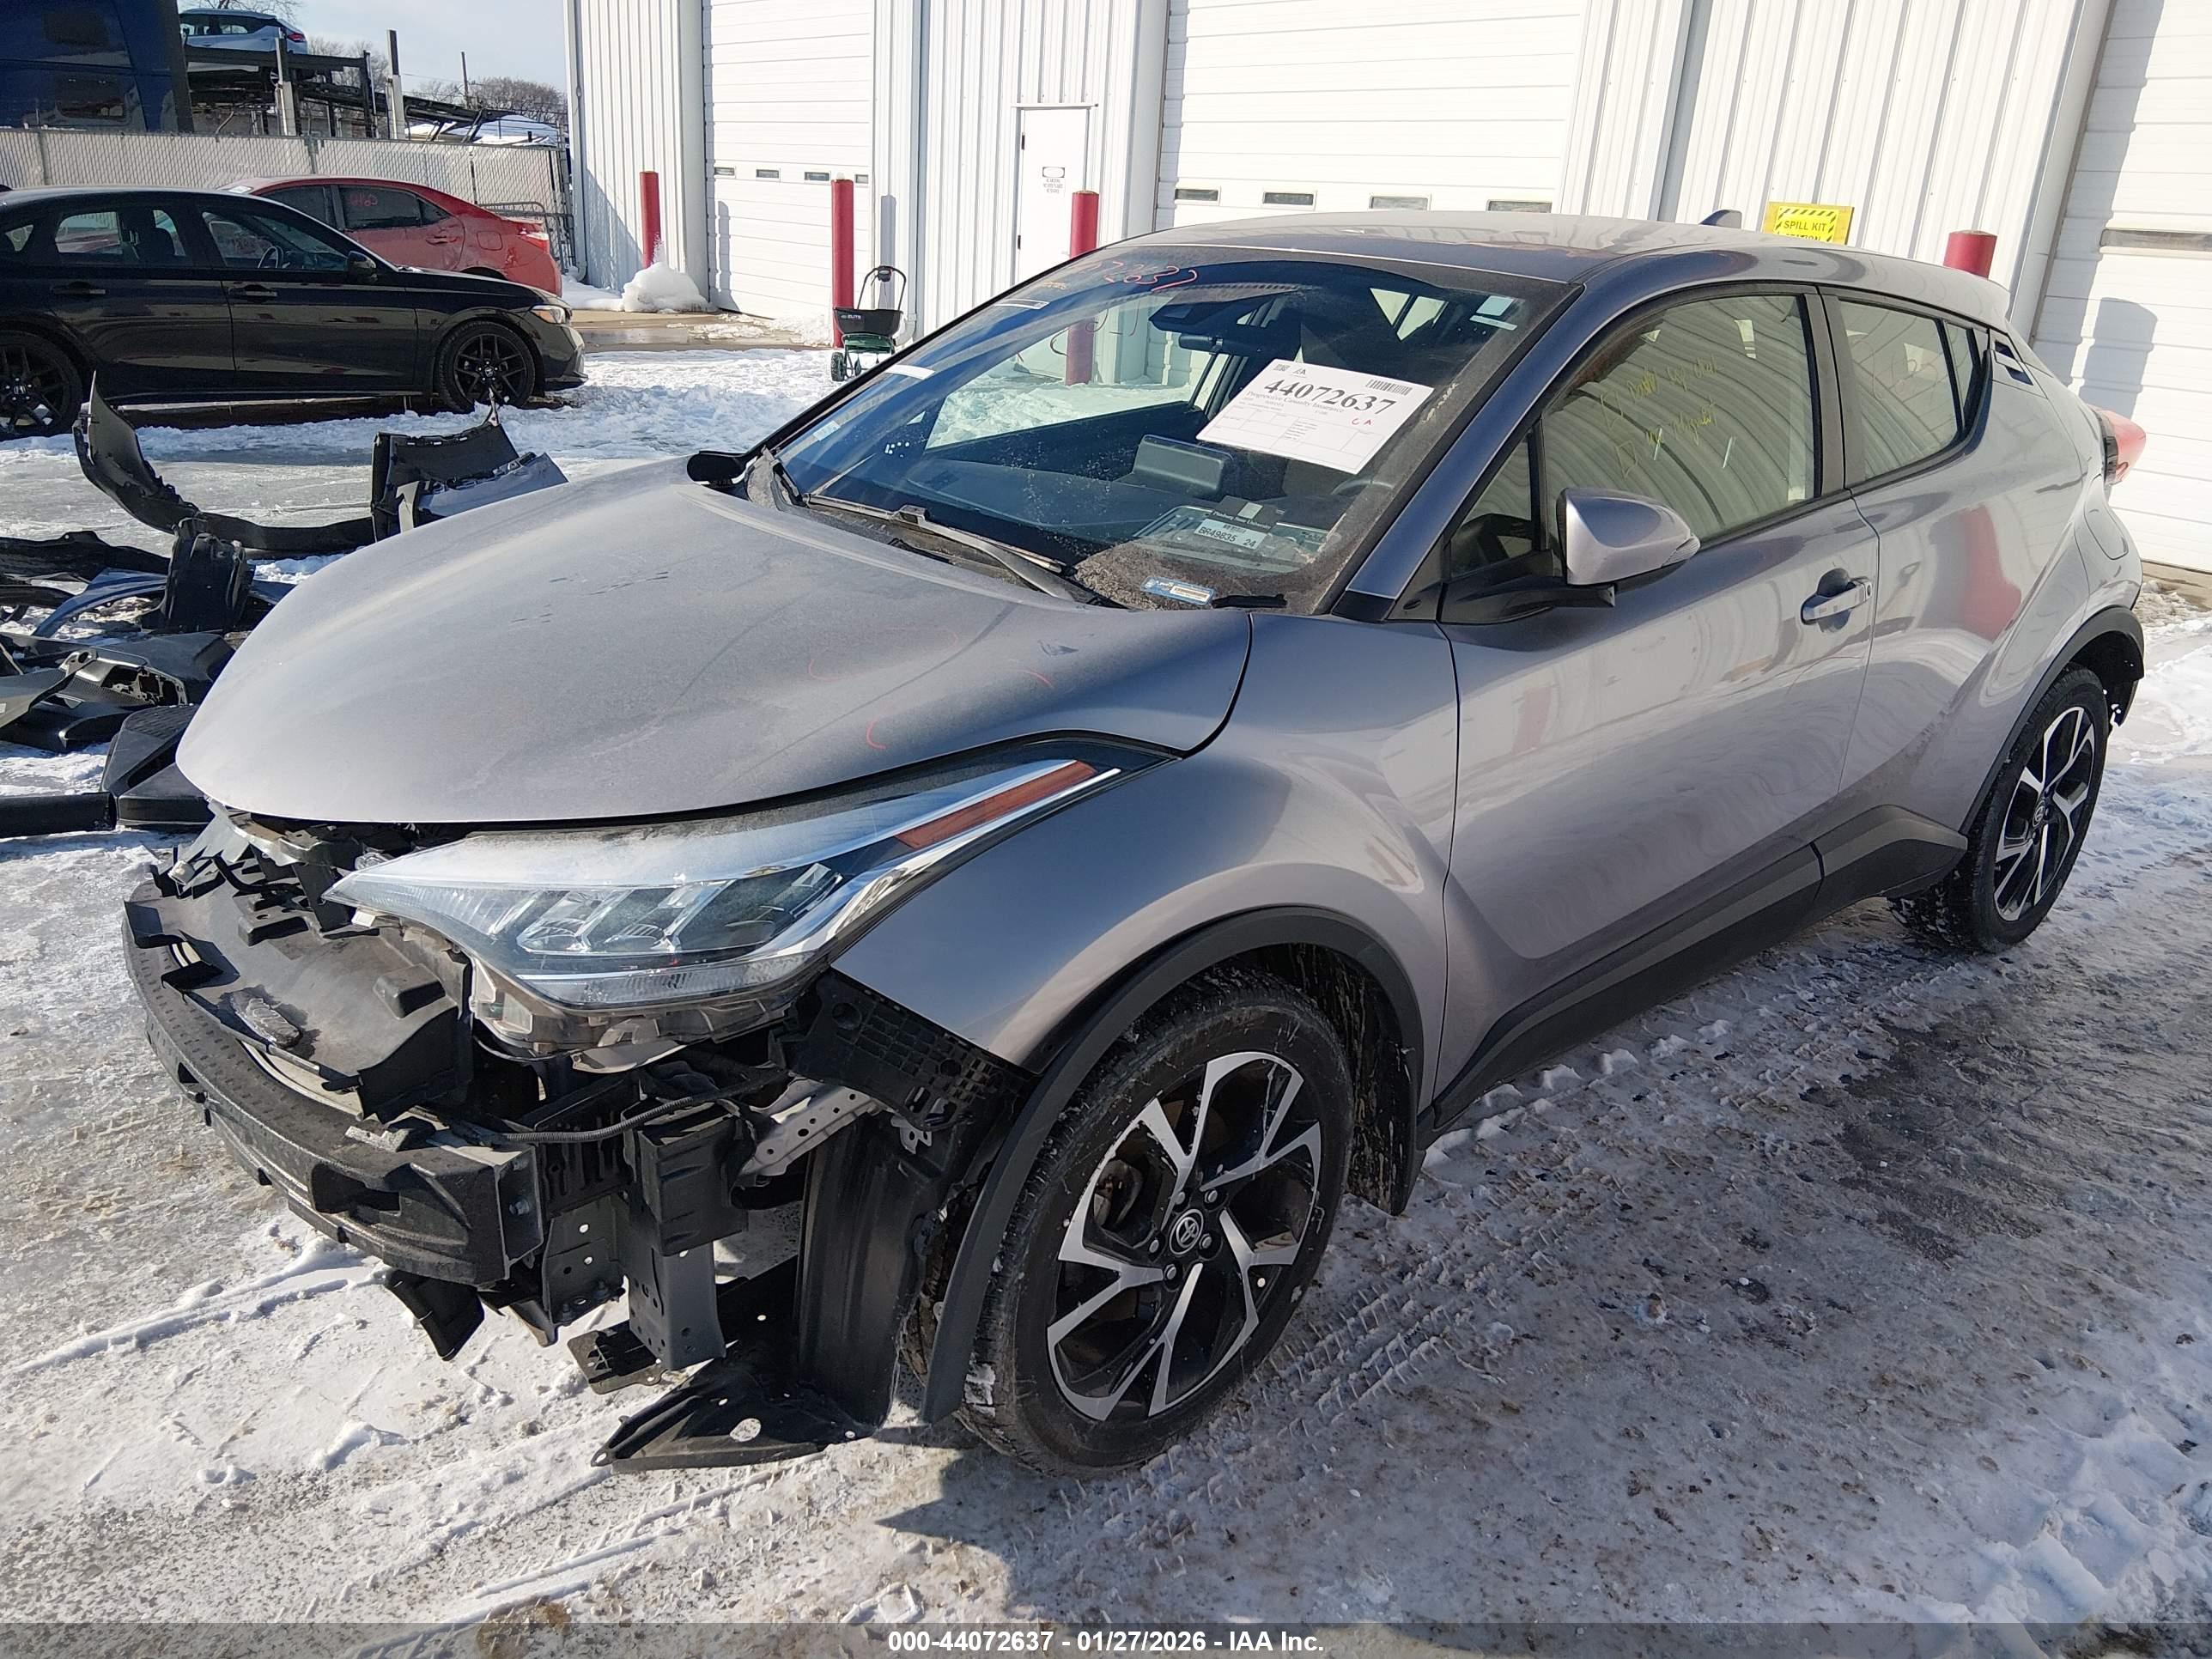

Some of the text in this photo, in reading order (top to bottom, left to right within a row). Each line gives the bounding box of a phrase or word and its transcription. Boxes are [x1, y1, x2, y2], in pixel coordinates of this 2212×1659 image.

[1784, 220, 1827, 232] SPILL KIT
[1264, 379, 1397, 416] 44072637
